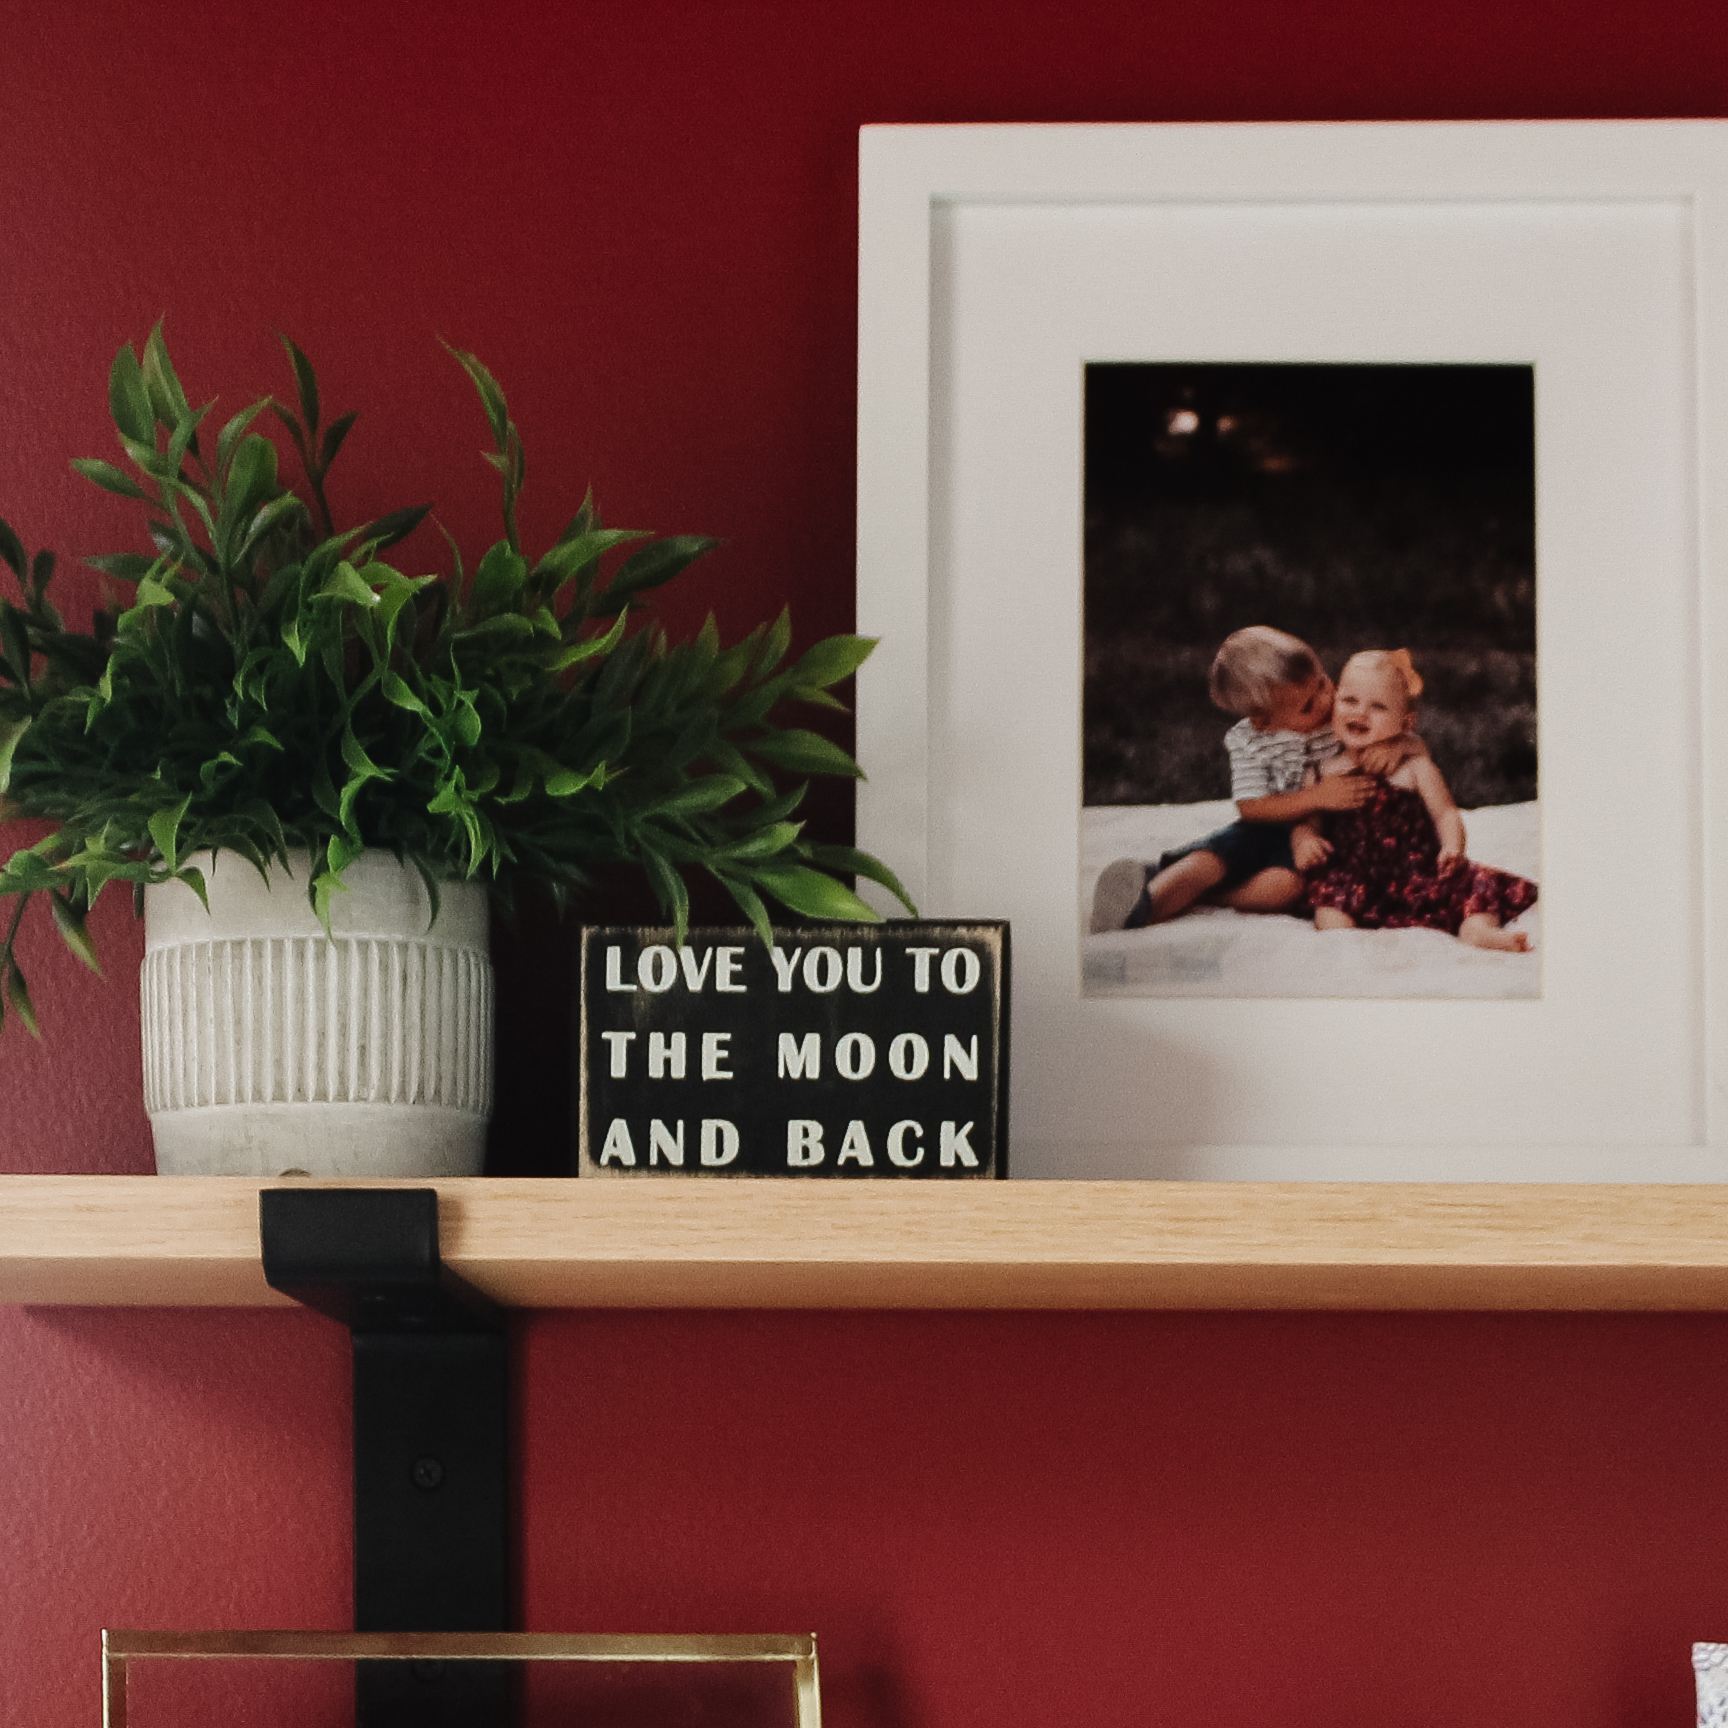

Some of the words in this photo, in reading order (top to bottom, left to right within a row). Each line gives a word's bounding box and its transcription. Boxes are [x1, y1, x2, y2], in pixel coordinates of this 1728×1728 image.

[605, 945, 747, 994] LOVE
[772, 946, 882, 995] YOU
[905, 947, 981, 995] TO
[601, 1030, 734, 1081] THE
[777, 1032, 978, 1081] MOON
[599, 1117, 740, 1167] AND
[786, 1119, 979, 1167] BACK
